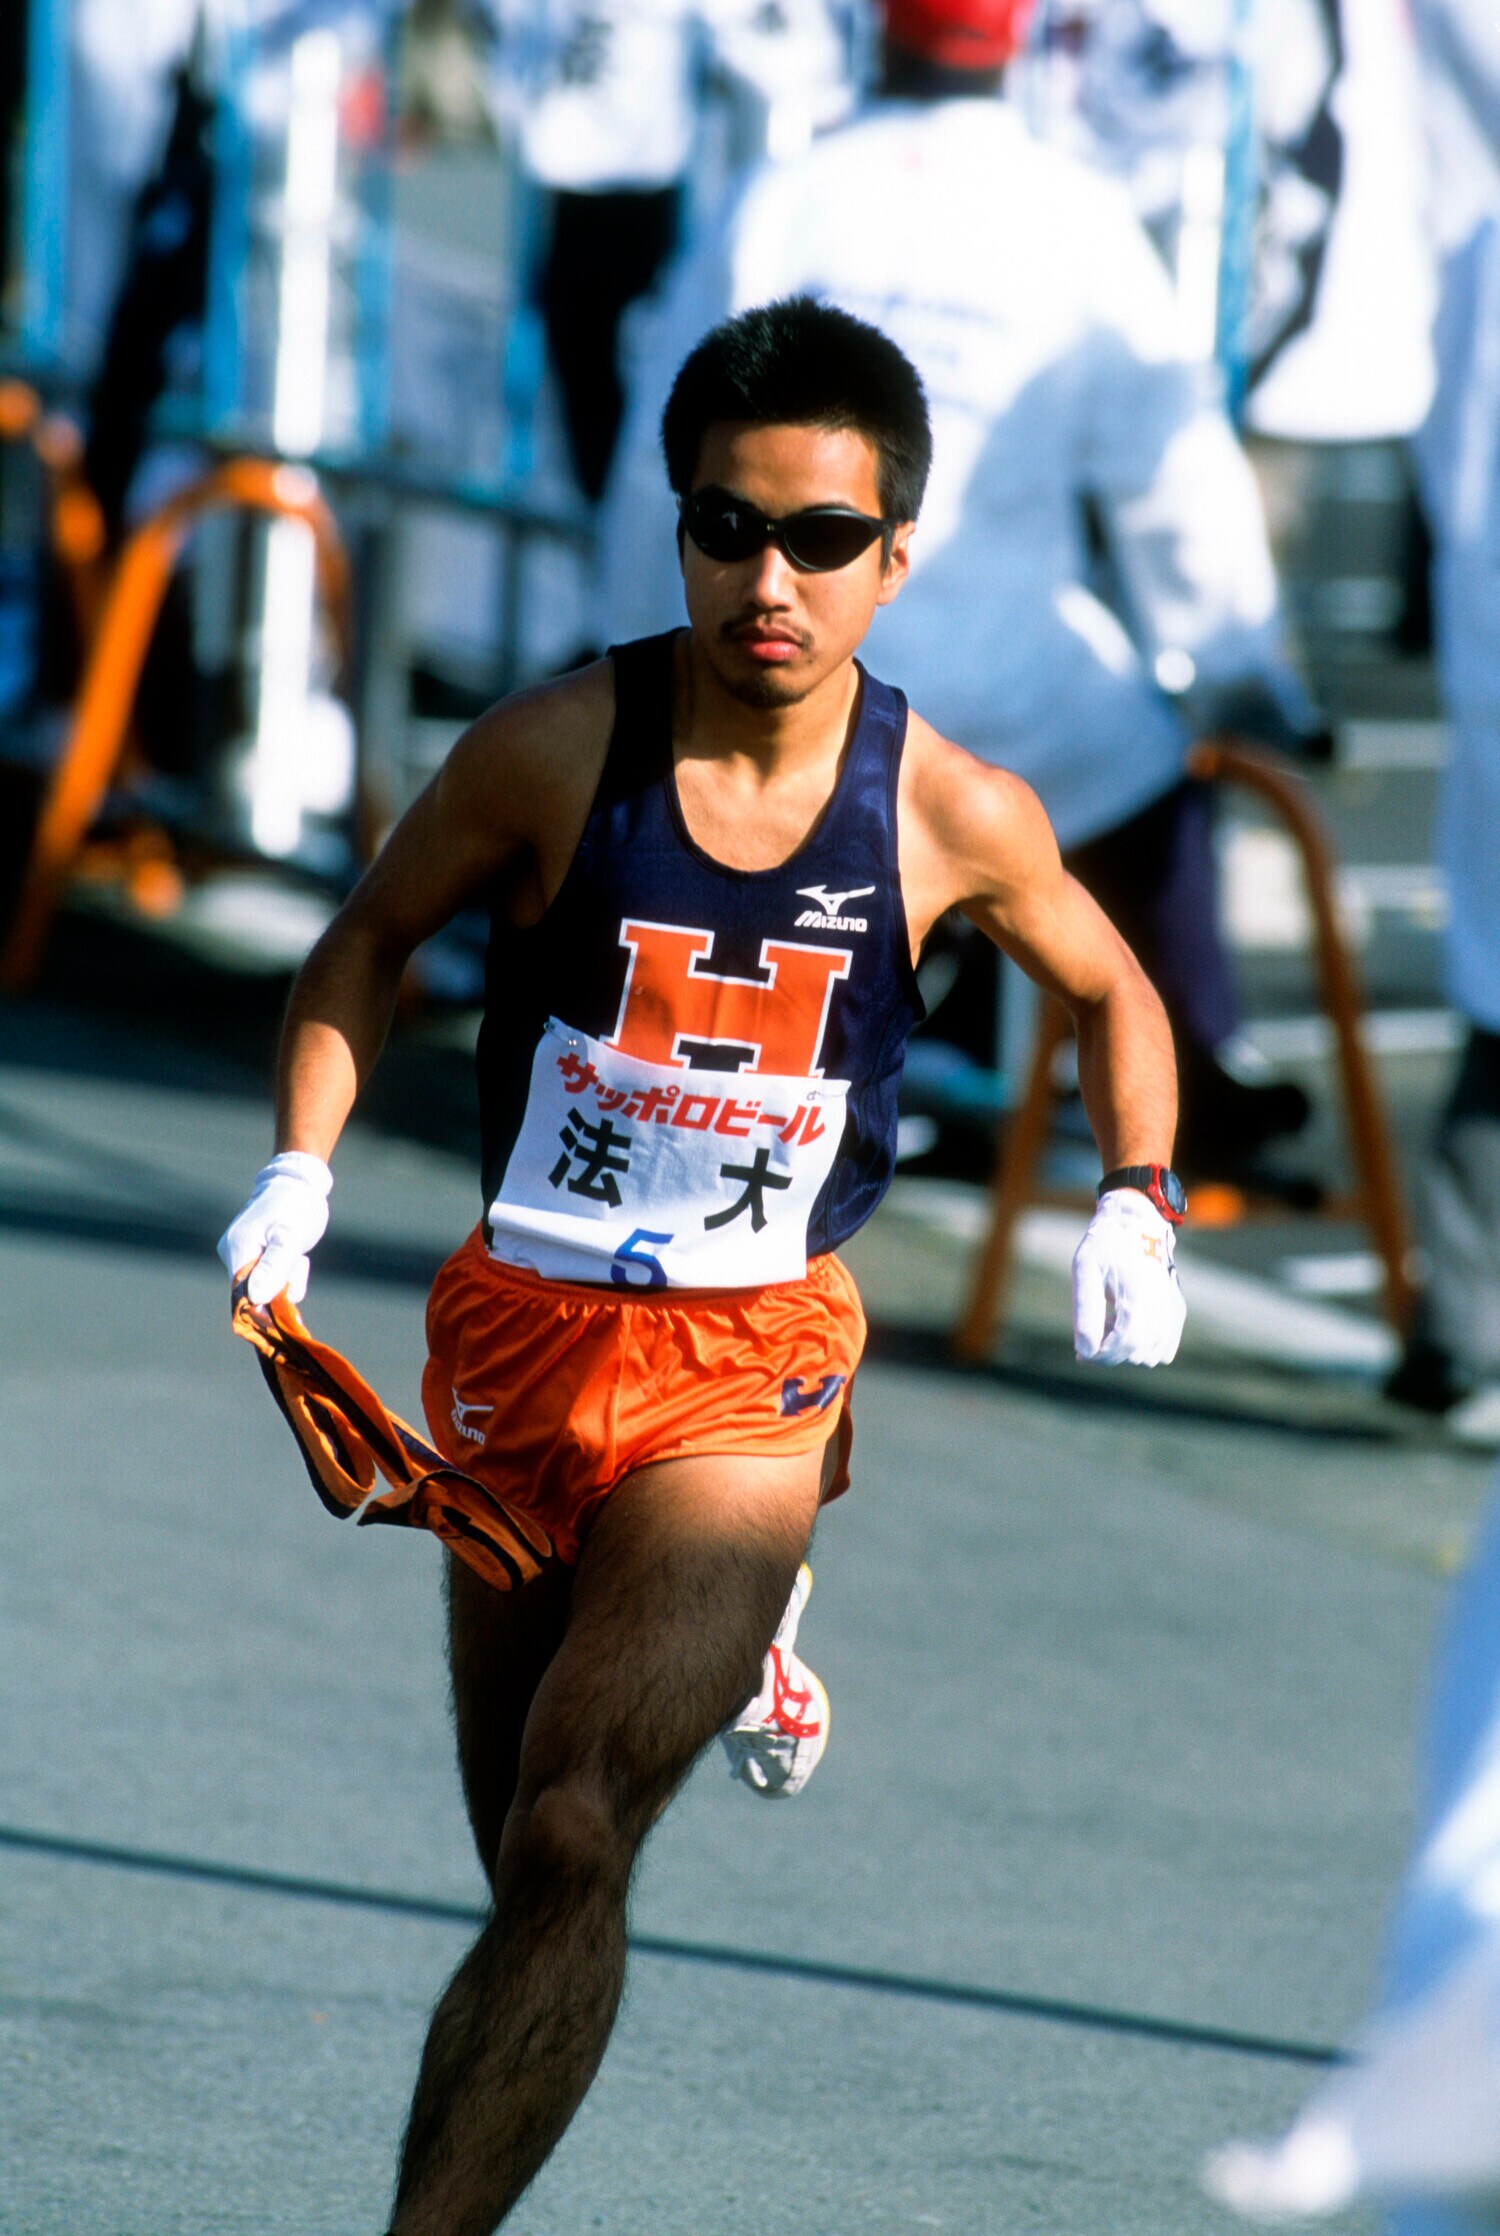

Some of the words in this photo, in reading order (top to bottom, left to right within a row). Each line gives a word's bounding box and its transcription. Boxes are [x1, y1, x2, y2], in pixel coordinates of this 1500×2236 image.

[602, 919, 852, 1080] H
[557, 1053, 825, 1146] サッポロビール
[611, 1229, 674, 1286] 5
